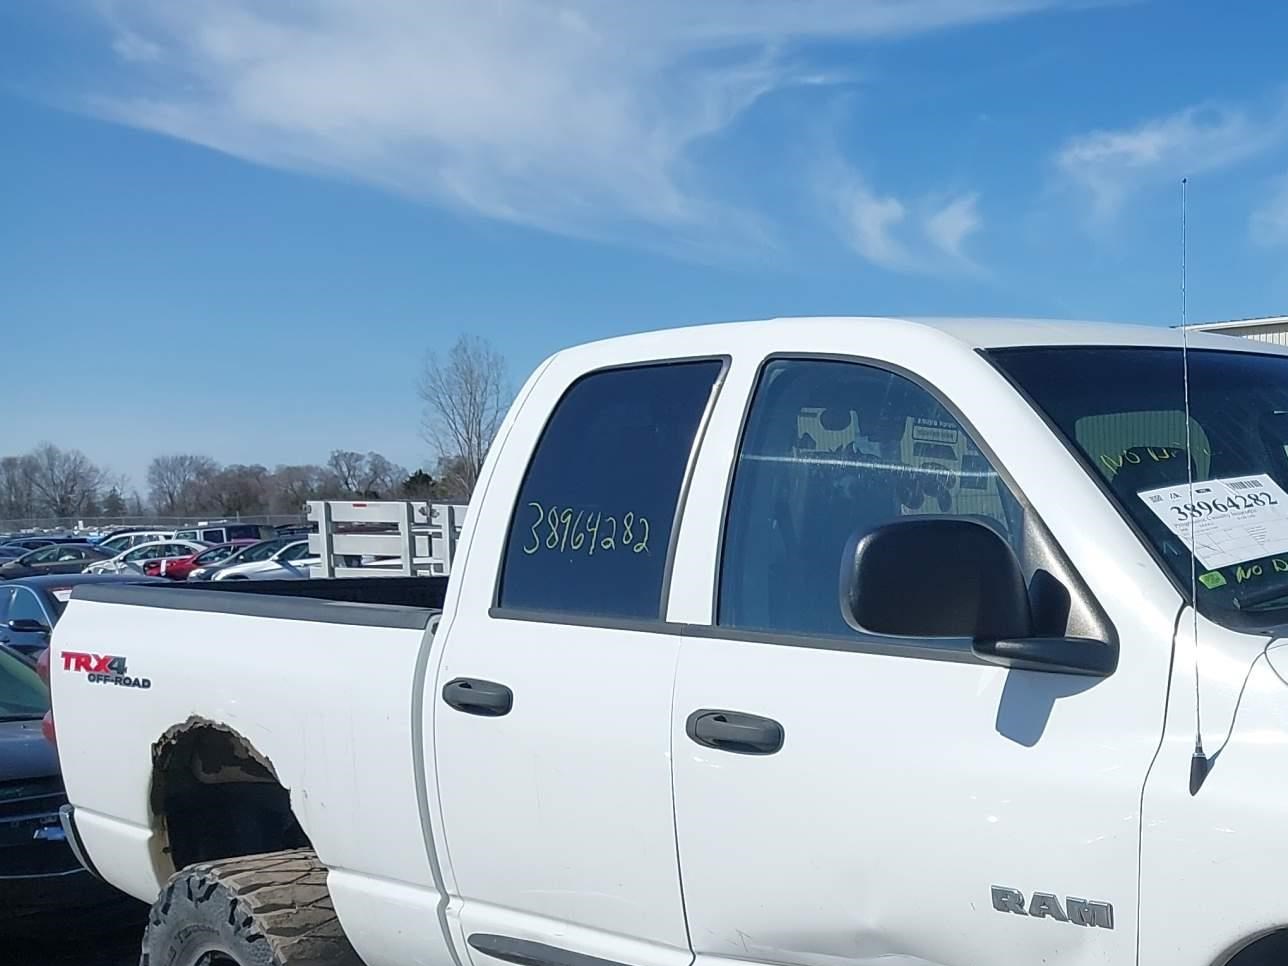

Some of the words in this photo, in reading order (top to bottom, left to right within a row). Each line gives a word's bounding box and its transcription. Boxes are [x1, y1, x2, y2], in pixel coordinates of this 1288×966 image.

[1171, 492, 1278, 522] 38964282
[523, 502, 649, 555] 38964282
[61, 651, 128, 675] TRX4
[87, 673, 151, 689] OFF-ROAD
[990, 885, 1114, 930] RAM
